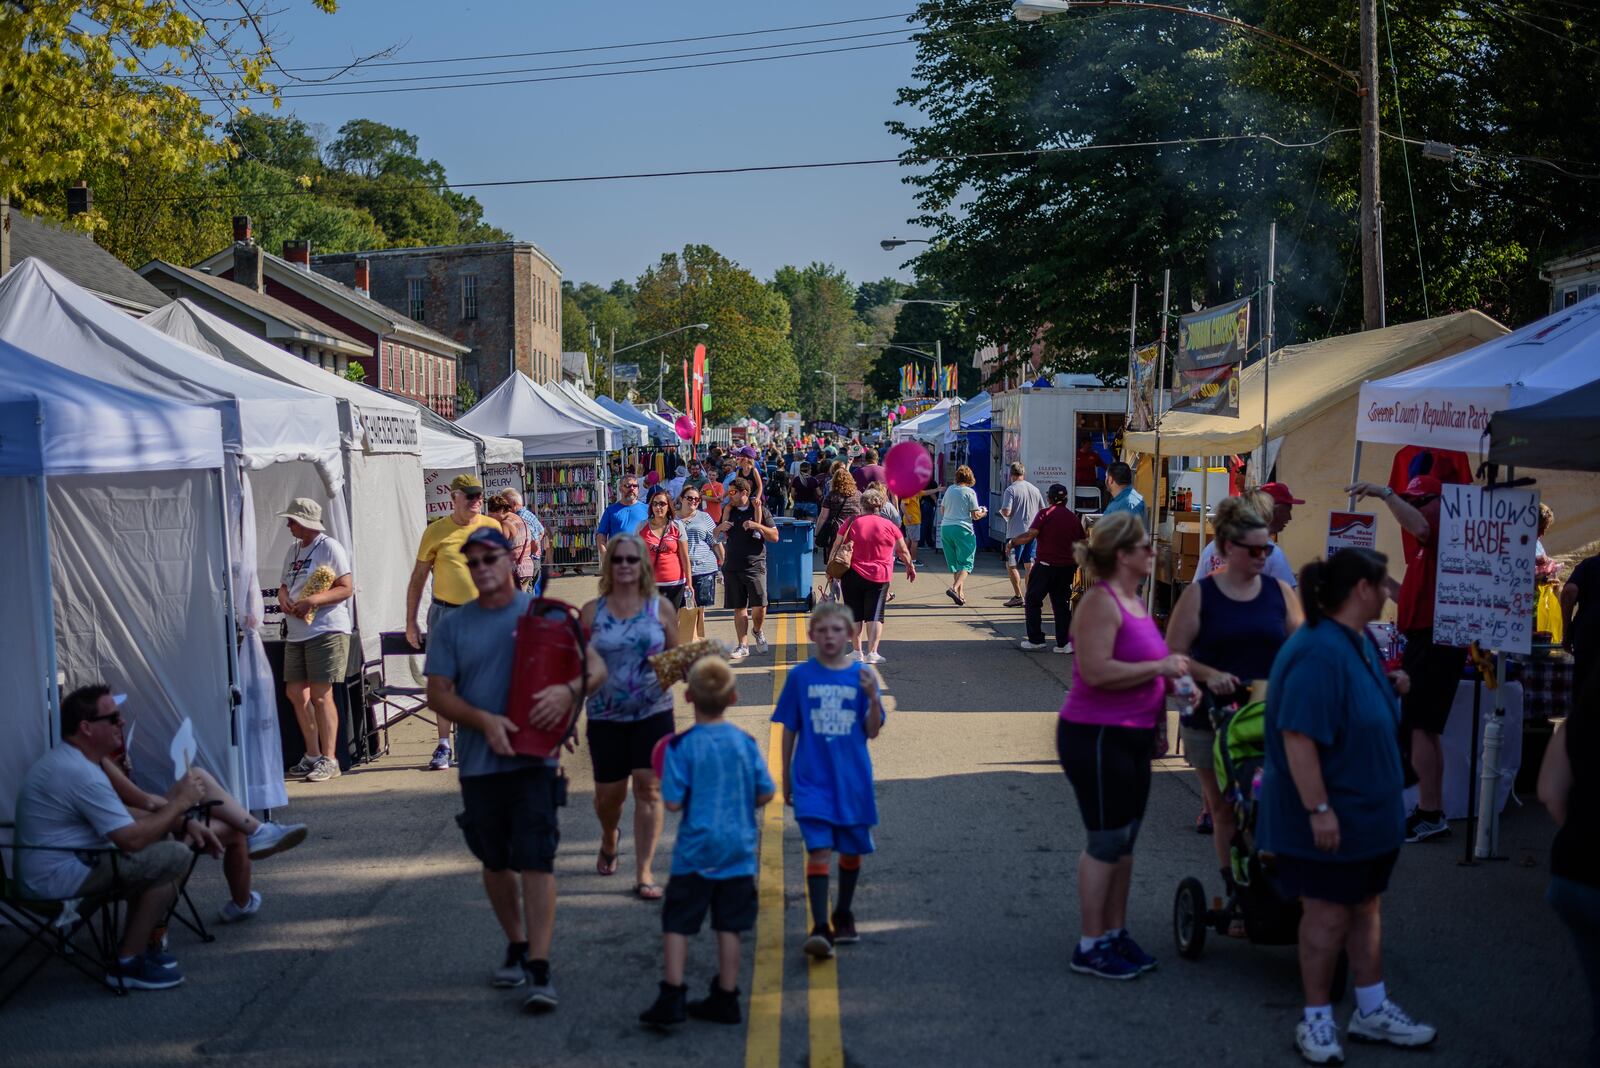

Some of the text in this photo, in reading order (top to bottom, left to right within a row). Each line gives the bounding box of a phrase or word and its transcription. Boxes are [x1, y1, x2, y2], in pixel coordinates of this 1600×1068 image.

[1368, 401, 1490, 432] Greene County Republican Party
[1442, 487, 1537, 527] Willow's
[1465, 520, 1512, 543] HOME
[1465, 538, 1510, 555] MADE
